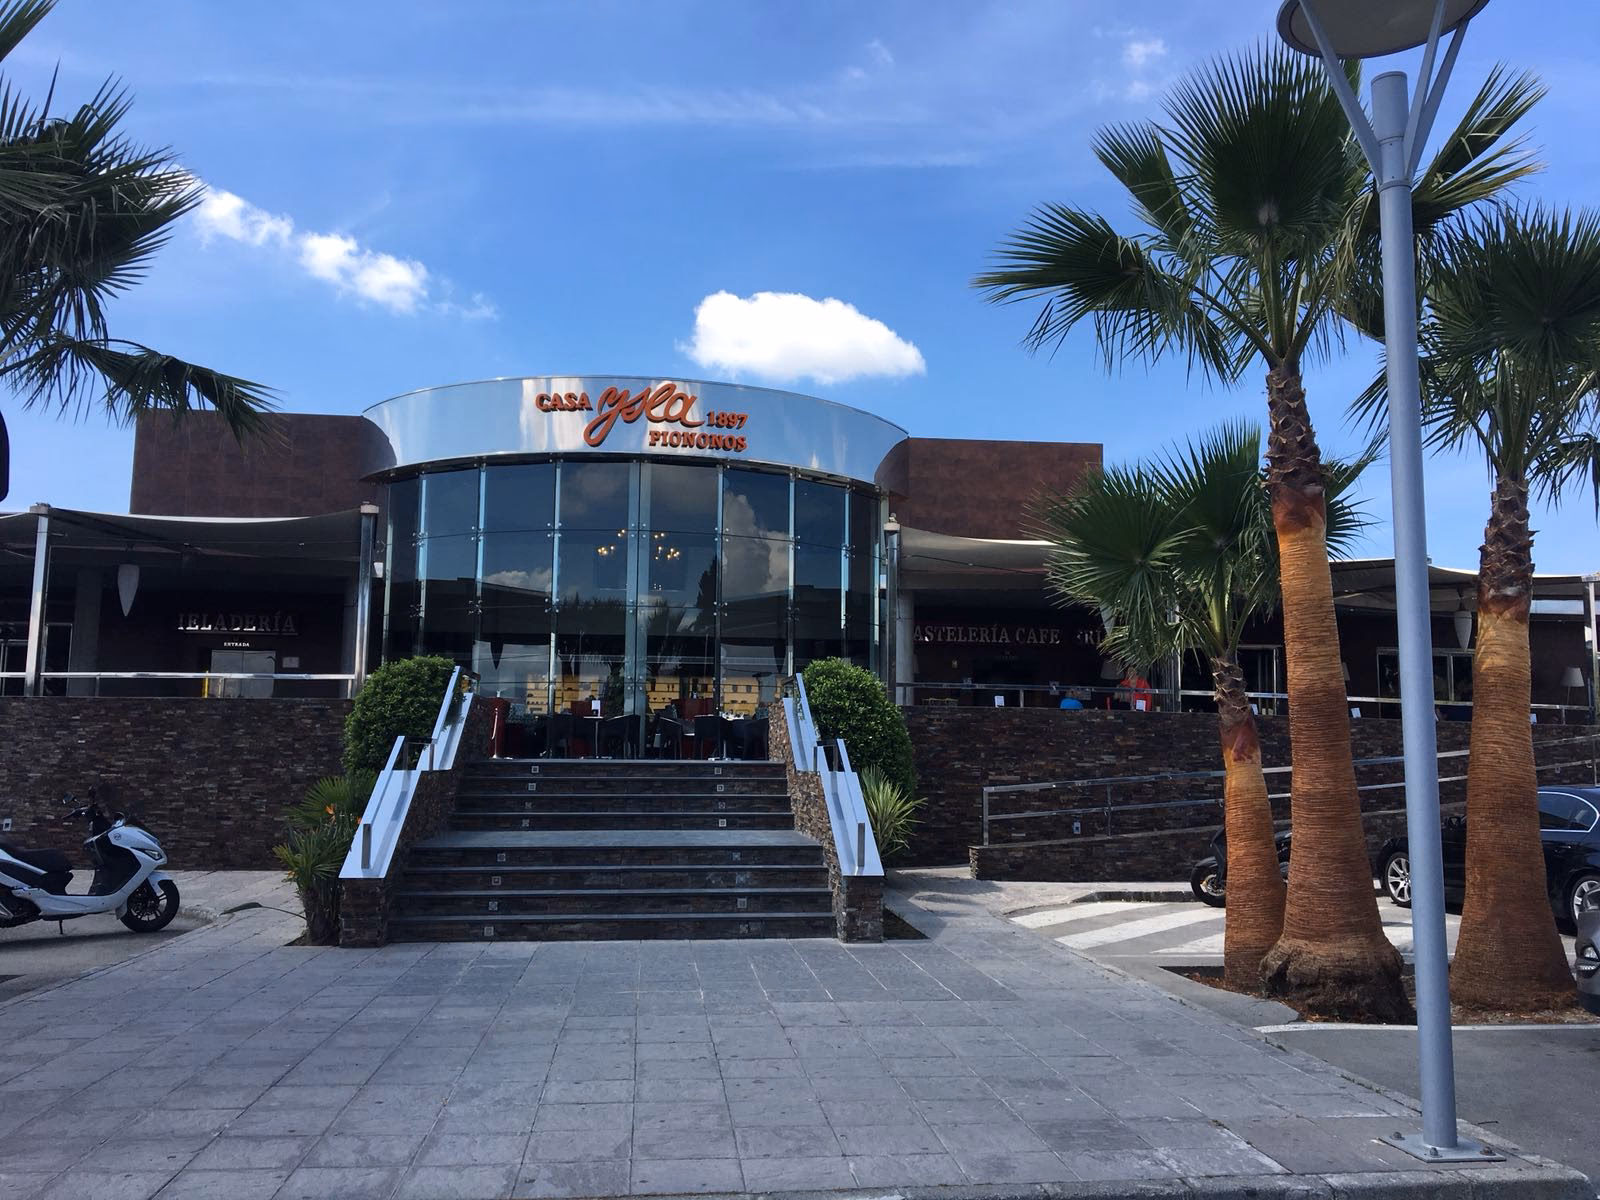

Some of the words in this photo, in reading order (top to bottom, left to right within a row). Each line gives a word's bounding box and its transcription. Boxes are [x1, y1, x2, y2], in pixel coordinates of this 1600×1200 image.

[535, 392, 593, 411] CASA
[706, 411, 749, 430] 1897
[649, 430, 747, 452] PIONONOS
[913, 624, 1010, 644] ASTELERÍA
